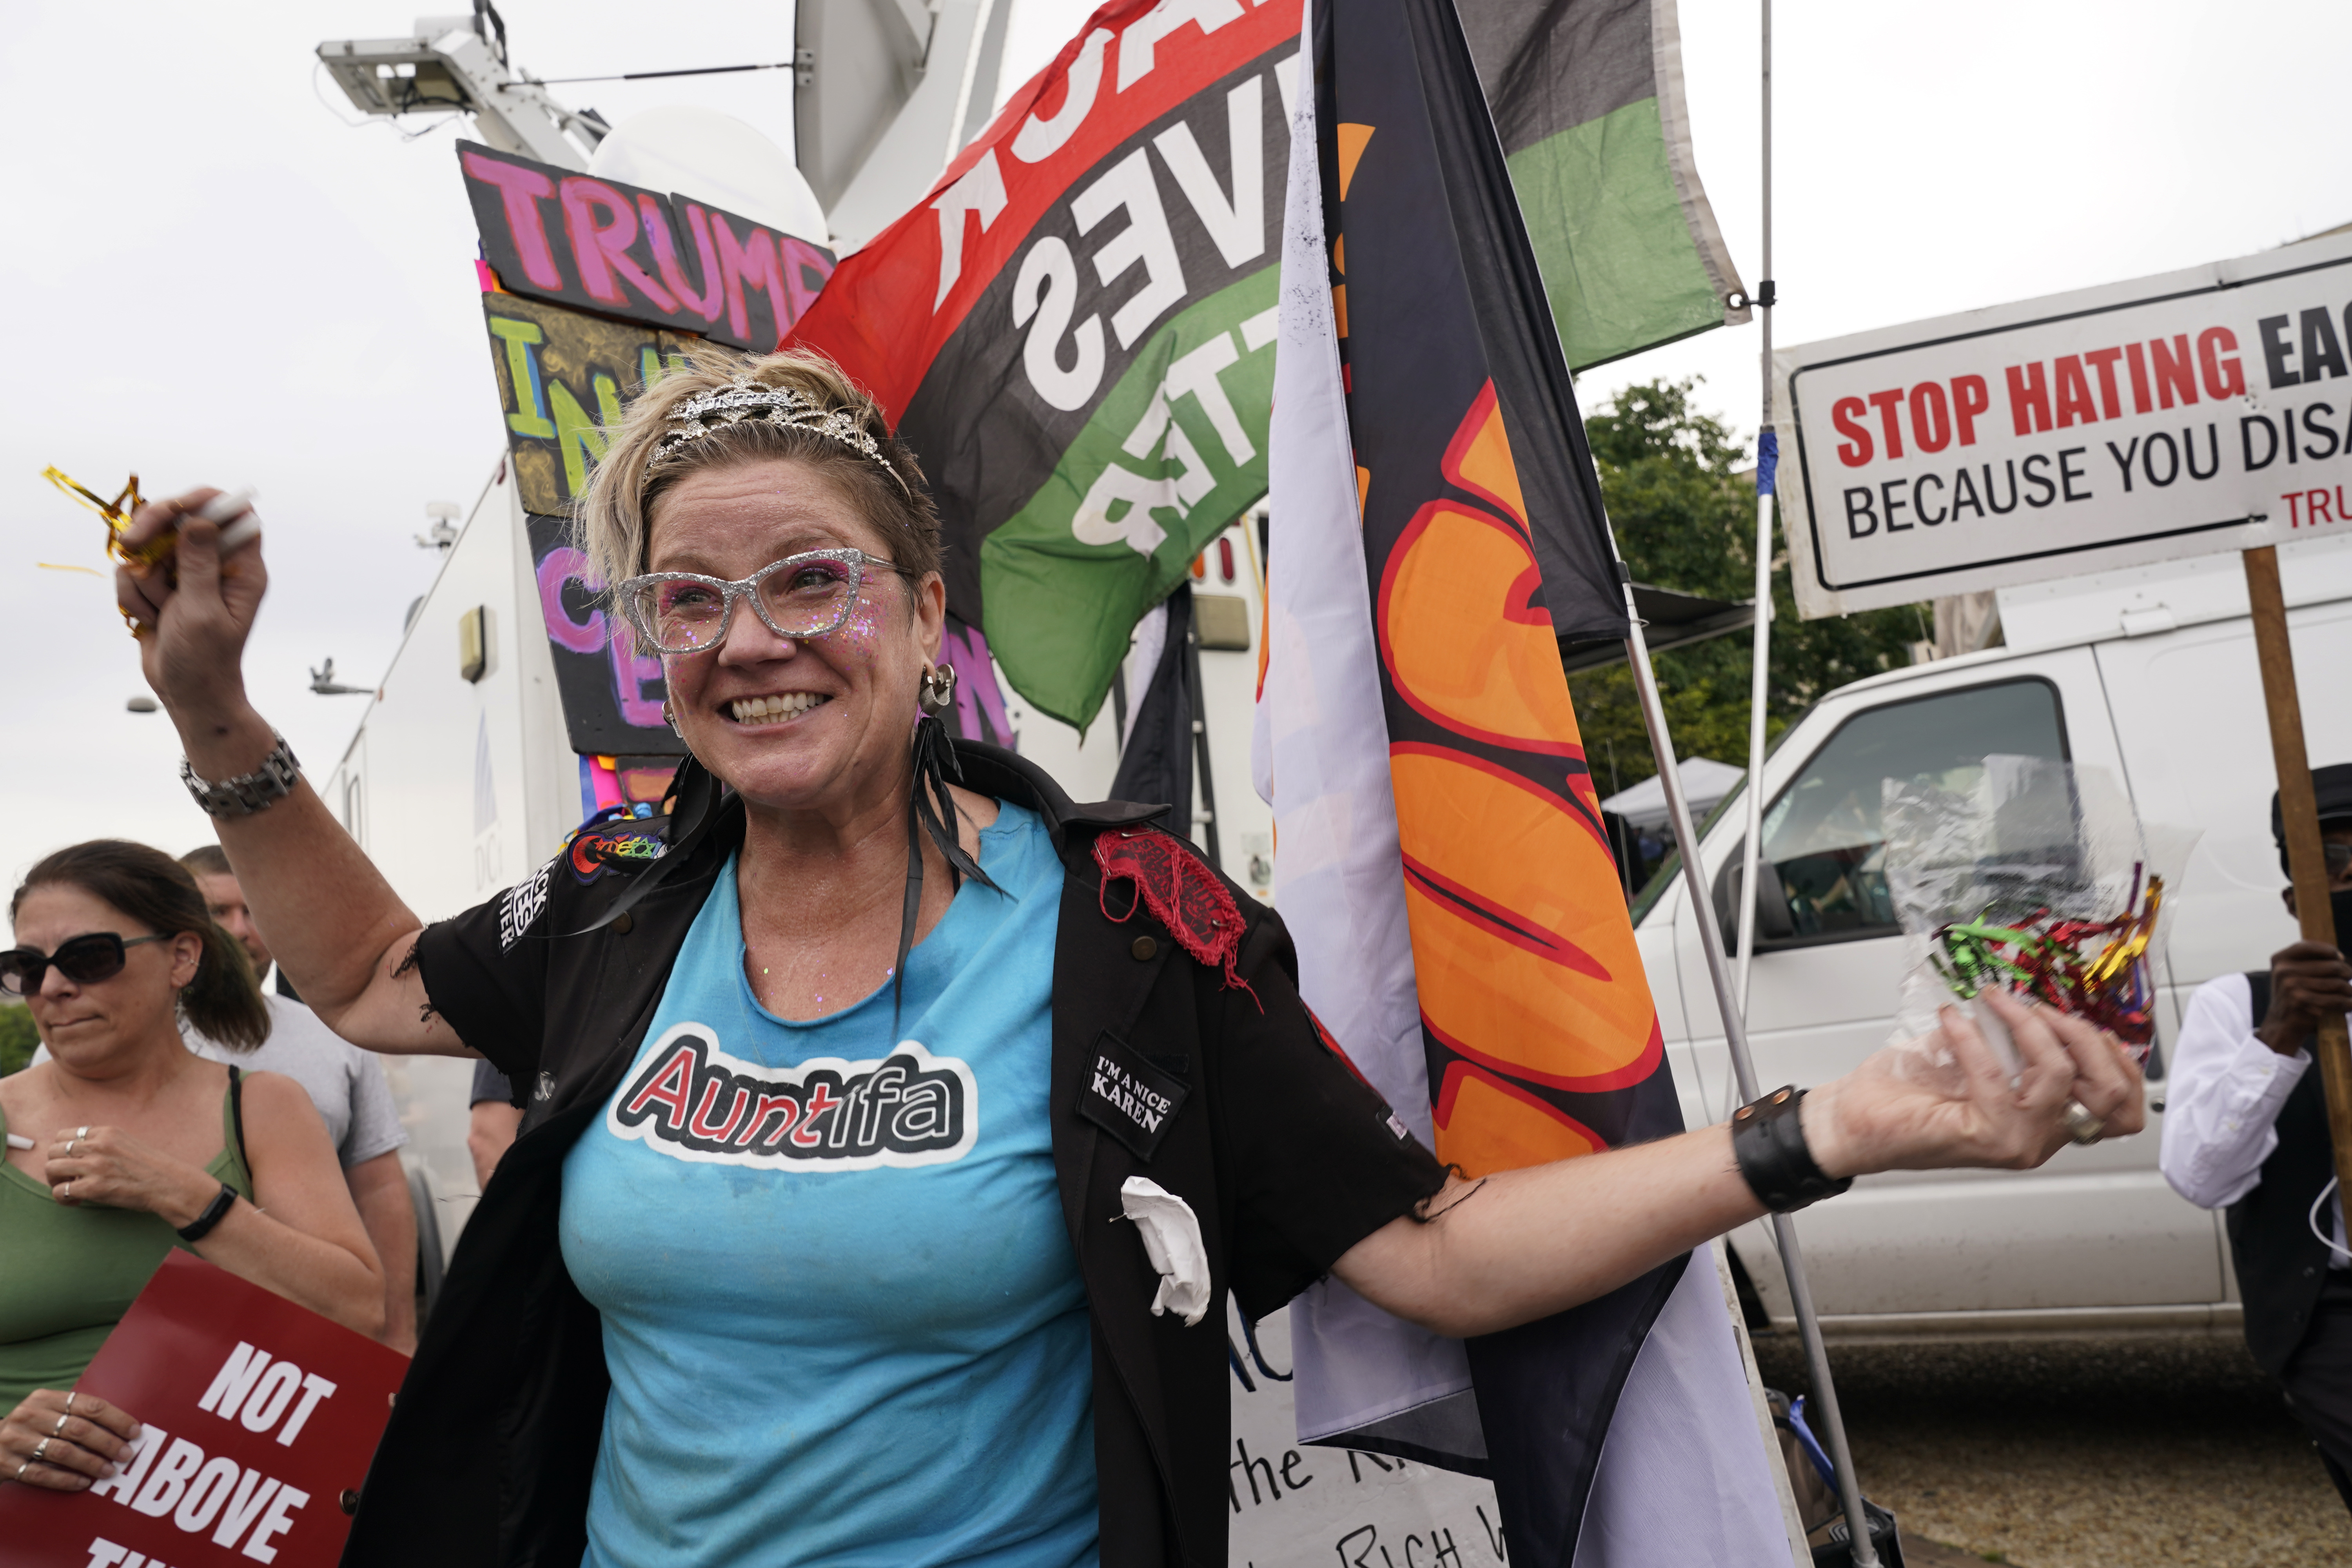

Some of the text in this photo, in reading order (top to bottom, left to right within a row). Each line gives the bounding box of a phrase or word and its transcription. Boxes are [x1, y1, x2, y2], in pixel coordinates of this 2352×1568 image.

[463, 151, 837, 342] TRUMP
[683, 392, 793, 421] AUNTIFA
[1832, 300, 2352, 467] STOP HATING EA
[1844, 396, 2352, 539] BECAUSE YOU DIS
[534, 860, 555, 914] ACK
[623, 1041, 954, 1151] Auntifa
[1091, 1071, 1163, 1134] KAREN
[1096, 1055, 1171, 1114] I'M A NICE
[197, 1341, 338, 1447] NOT
[89, 1423, 311, 1565] ABOVE
